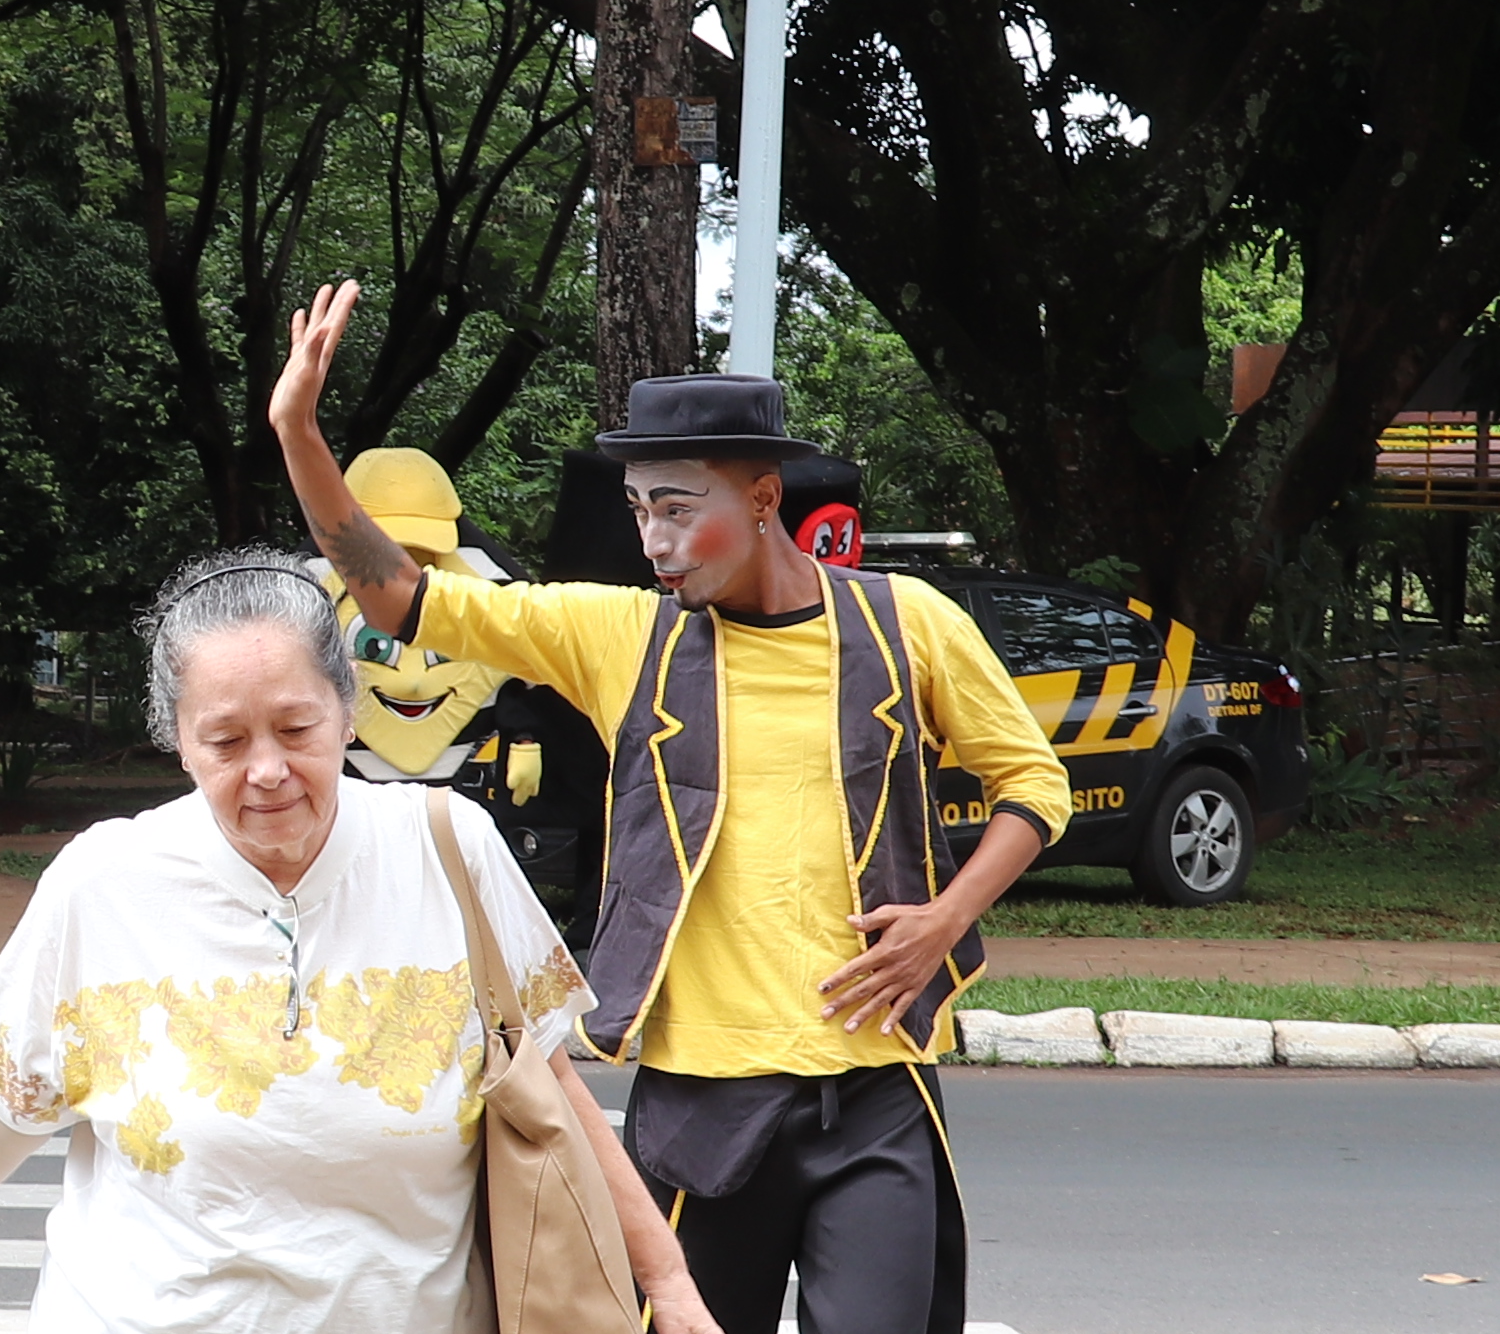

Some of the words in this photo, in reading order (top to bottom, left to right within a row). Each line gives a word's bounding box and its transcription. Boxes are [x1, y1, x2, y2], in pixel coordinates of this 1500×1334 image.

[1202, 682, 1259, 701] DT-607
[1207, 705, 1249, 717] DETRAN
[1249, 704, 1262, 715] DF
